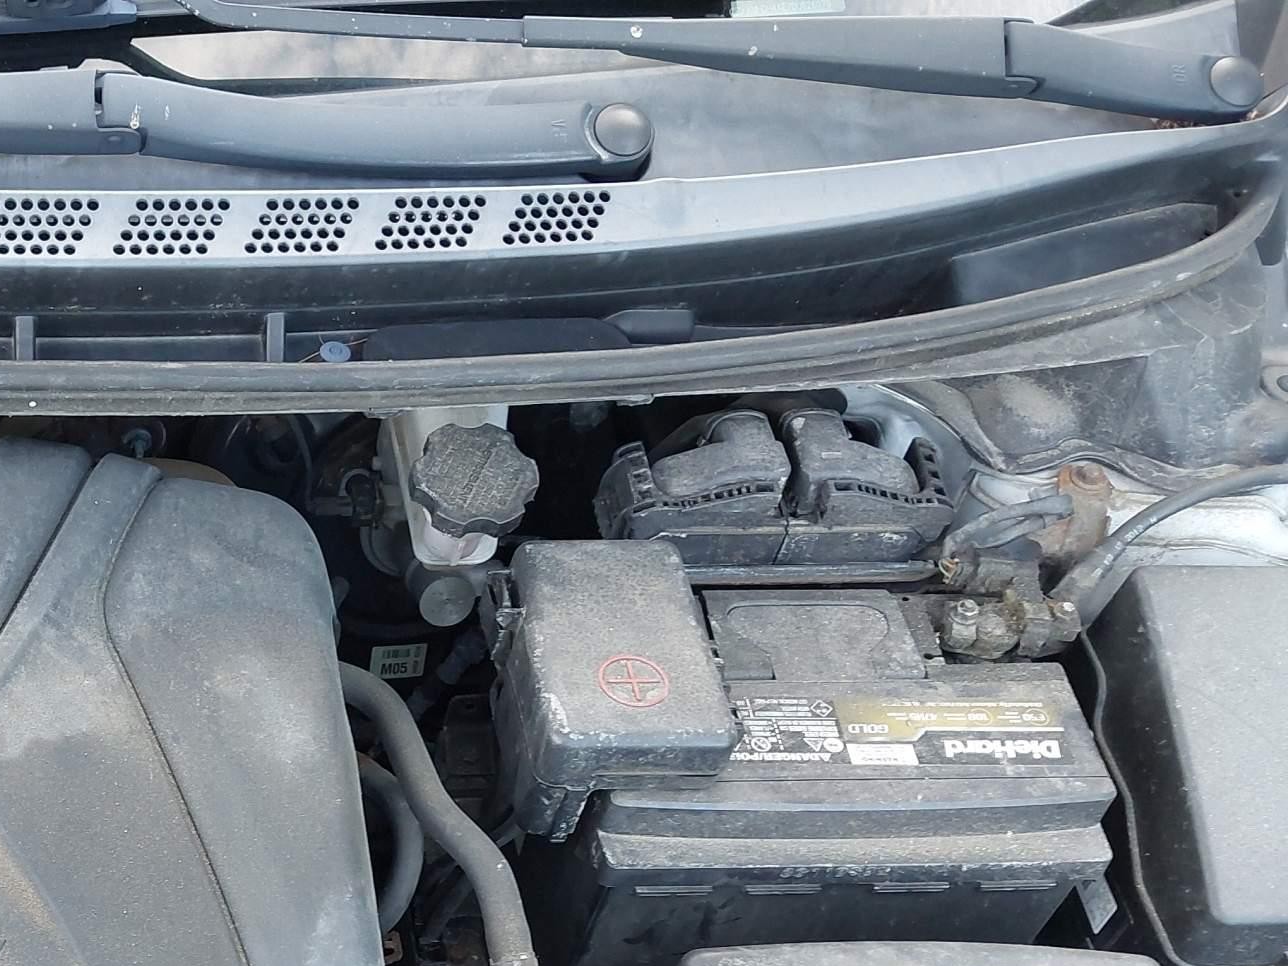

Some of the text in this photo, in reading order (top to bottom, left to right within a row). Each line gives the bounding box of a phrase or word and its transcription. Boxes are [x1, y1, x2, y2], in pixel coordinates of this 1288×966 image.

[380, 662, 408, 675] M05
[847, 723, 889, 734] GOLD
[943, 739, 1061, 759] DieHard
